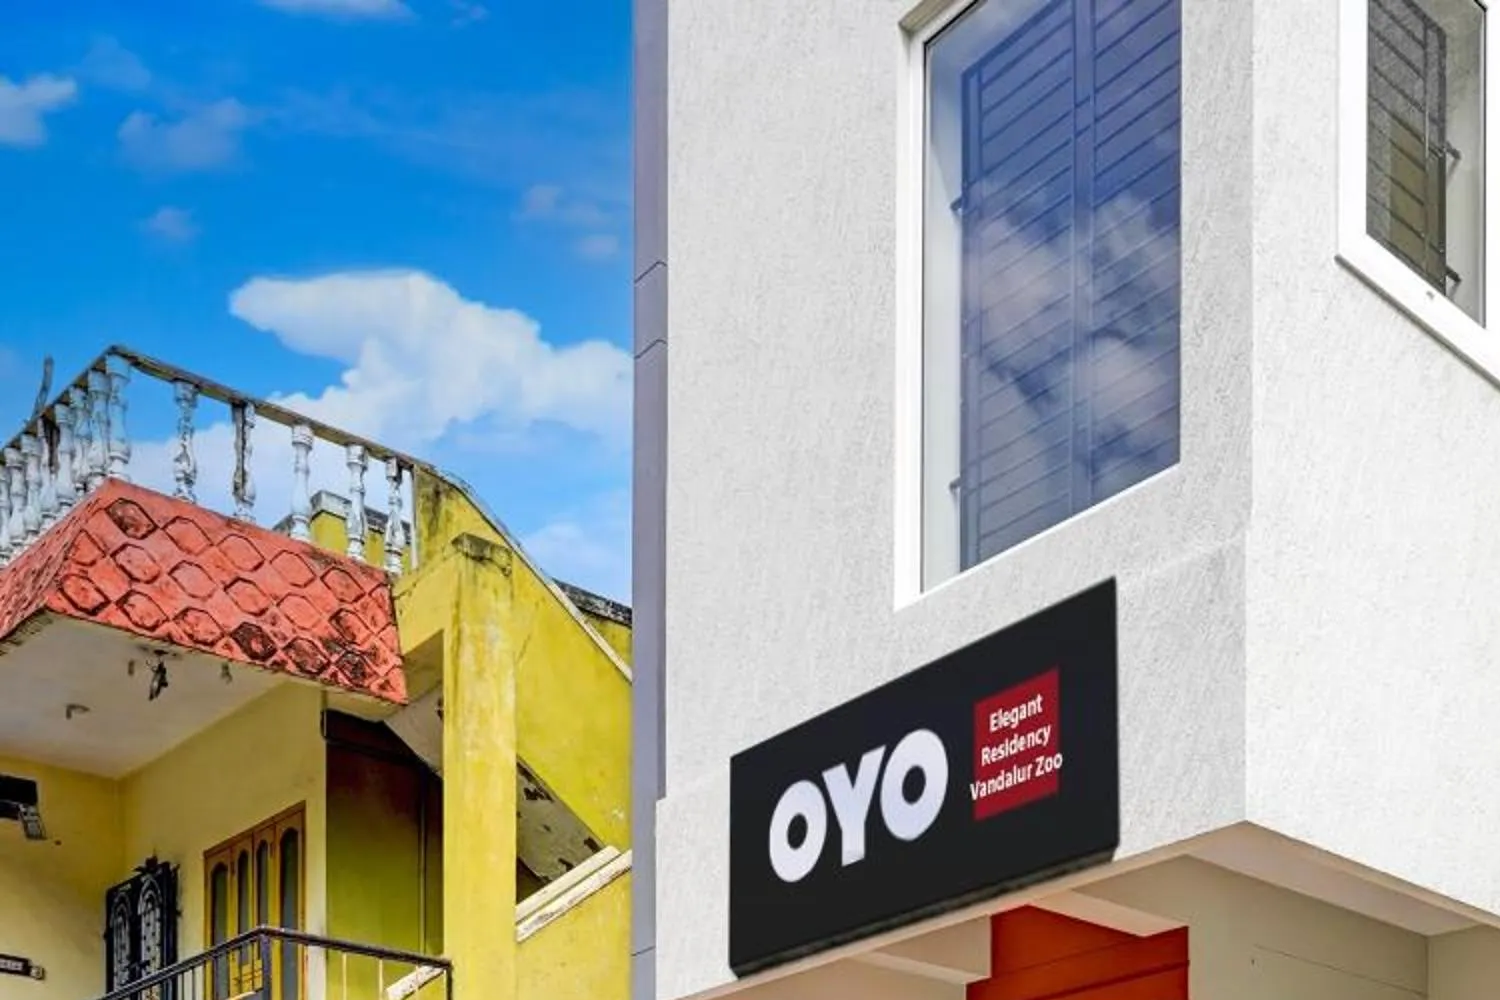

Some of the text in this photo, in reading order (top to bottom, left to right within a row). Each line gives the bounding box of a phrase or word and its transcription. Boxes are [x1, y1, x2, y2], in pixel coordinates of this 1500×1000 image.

[989, 693, 1043, 733] Elegant
[981, 724, 1051, 767] Residency
[970, 752, 1063, 801] Vandalur Zoo
[769, 728, 949, 883] OYO
